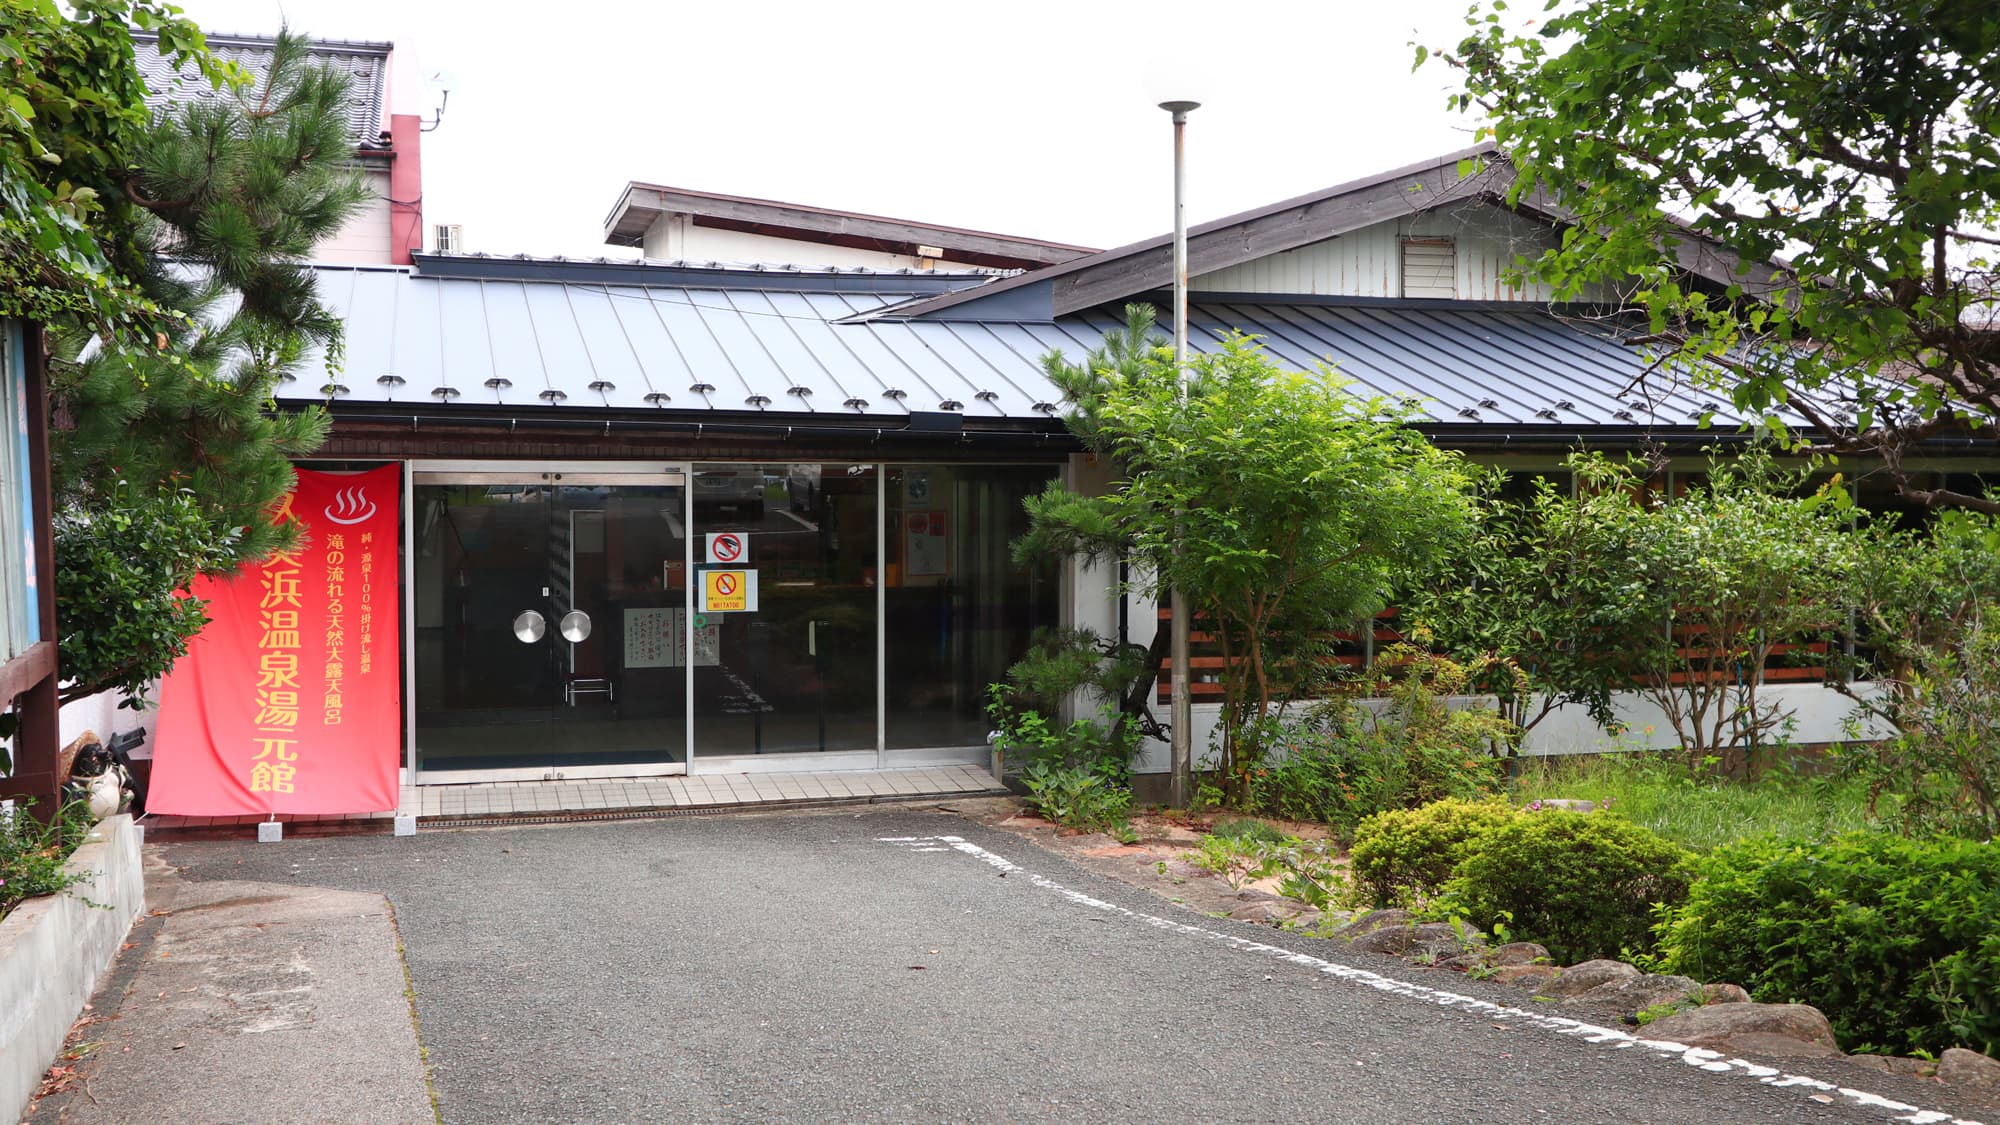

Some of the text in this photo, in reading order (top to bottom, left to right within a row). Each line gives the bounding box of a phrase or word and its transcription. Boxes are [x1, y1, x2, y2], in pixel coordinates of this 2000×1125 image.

[322, 533, 345, 725] 滝の流れる天然大露天風呂
